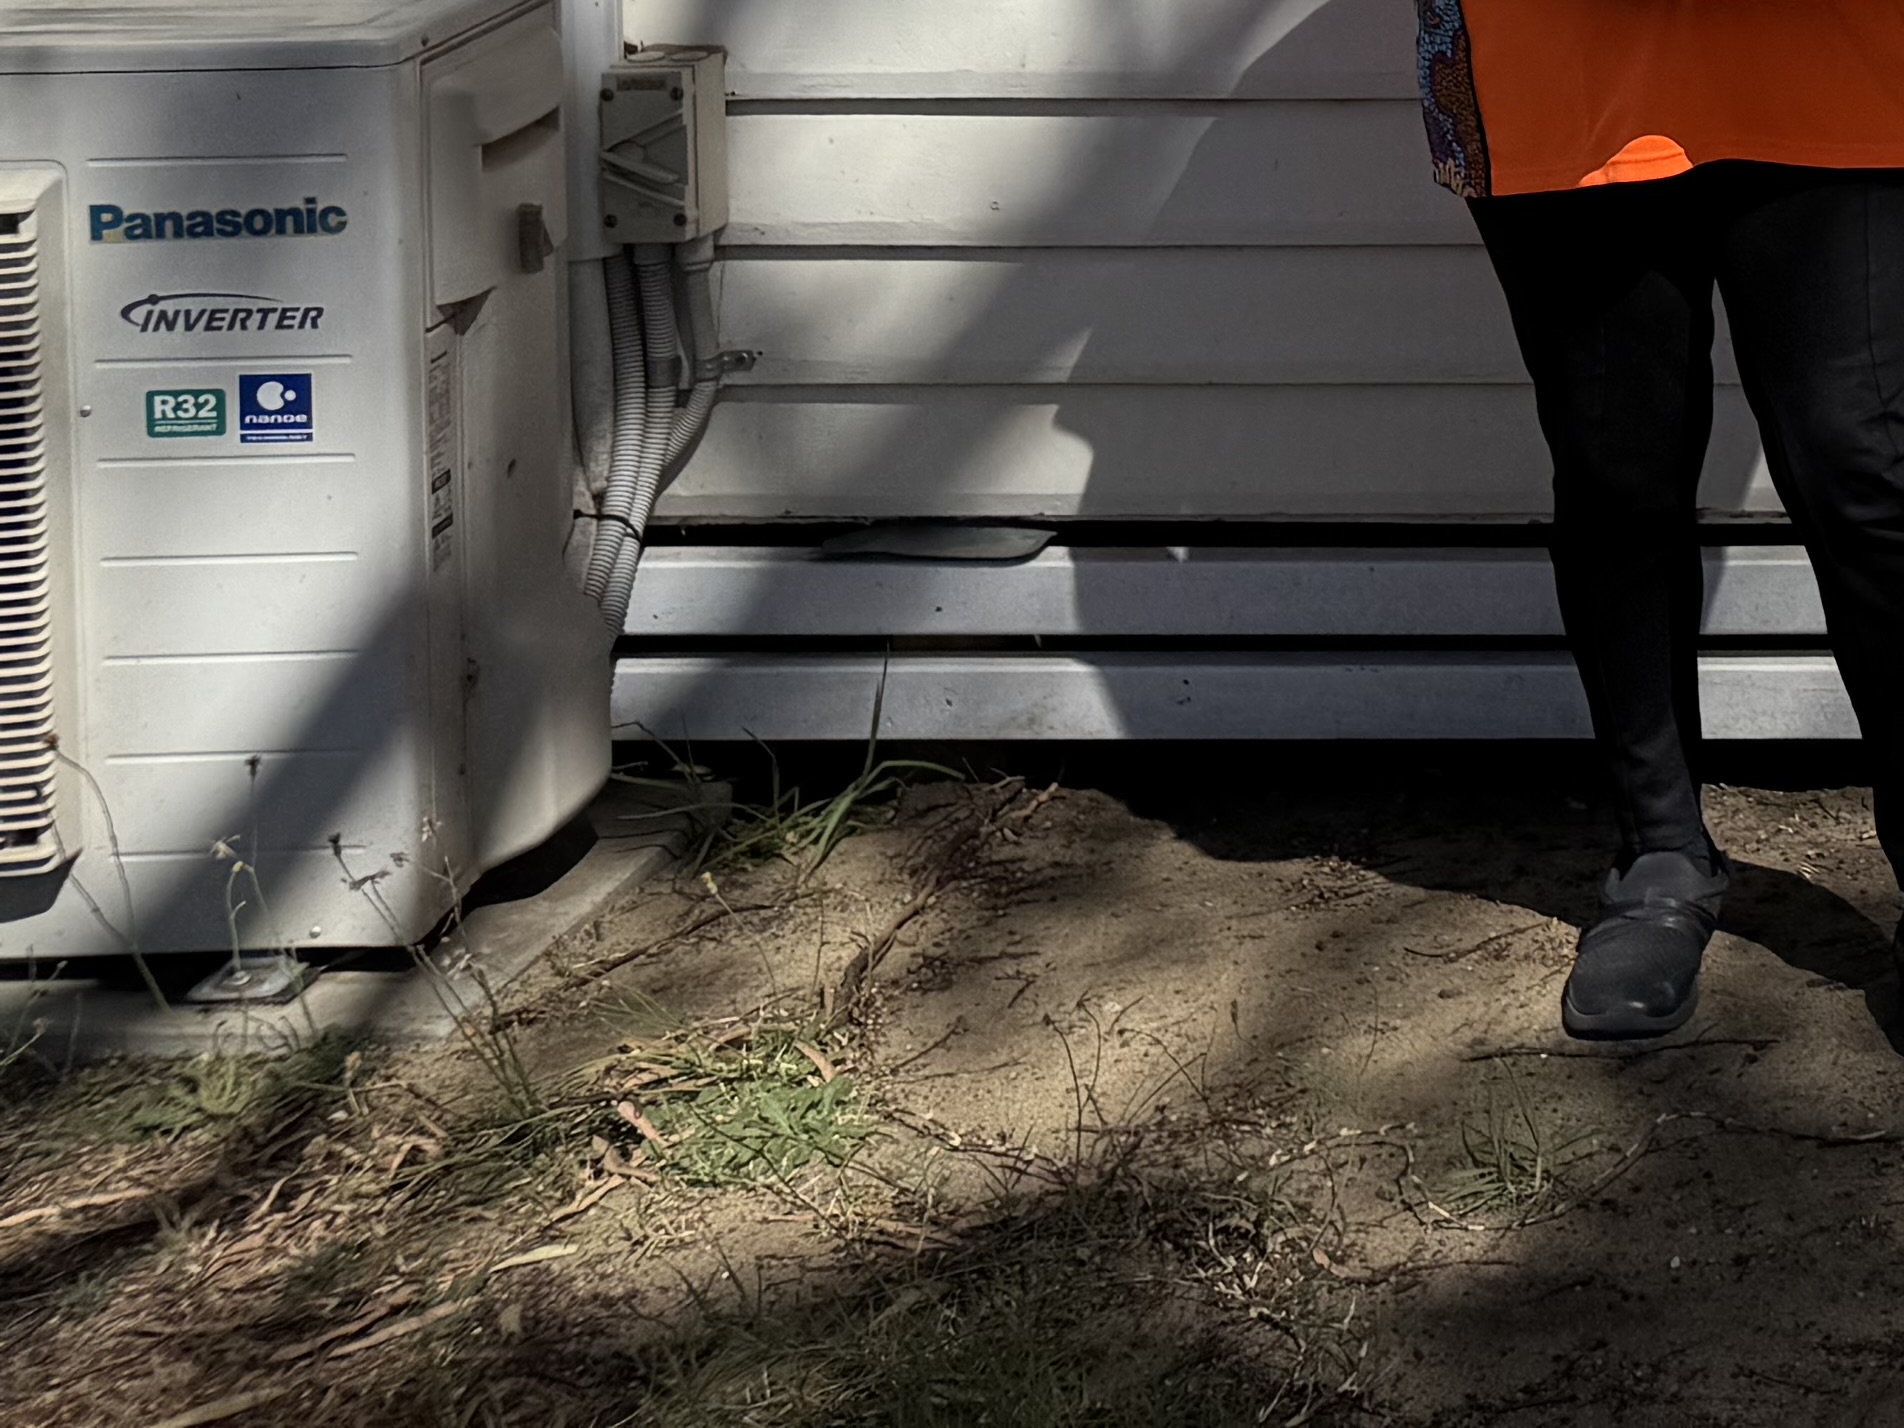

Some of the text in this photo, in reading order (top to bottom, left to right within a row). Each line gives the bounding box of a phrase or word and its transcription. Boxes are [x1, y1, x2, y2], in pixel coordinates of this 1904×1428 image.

[88, 196, 348, 242] Panasonic
[140, 306, 325, 333] INVERTER
[153, 393, 218, 419] R32
[244, 413, 308, 424] nanoe
